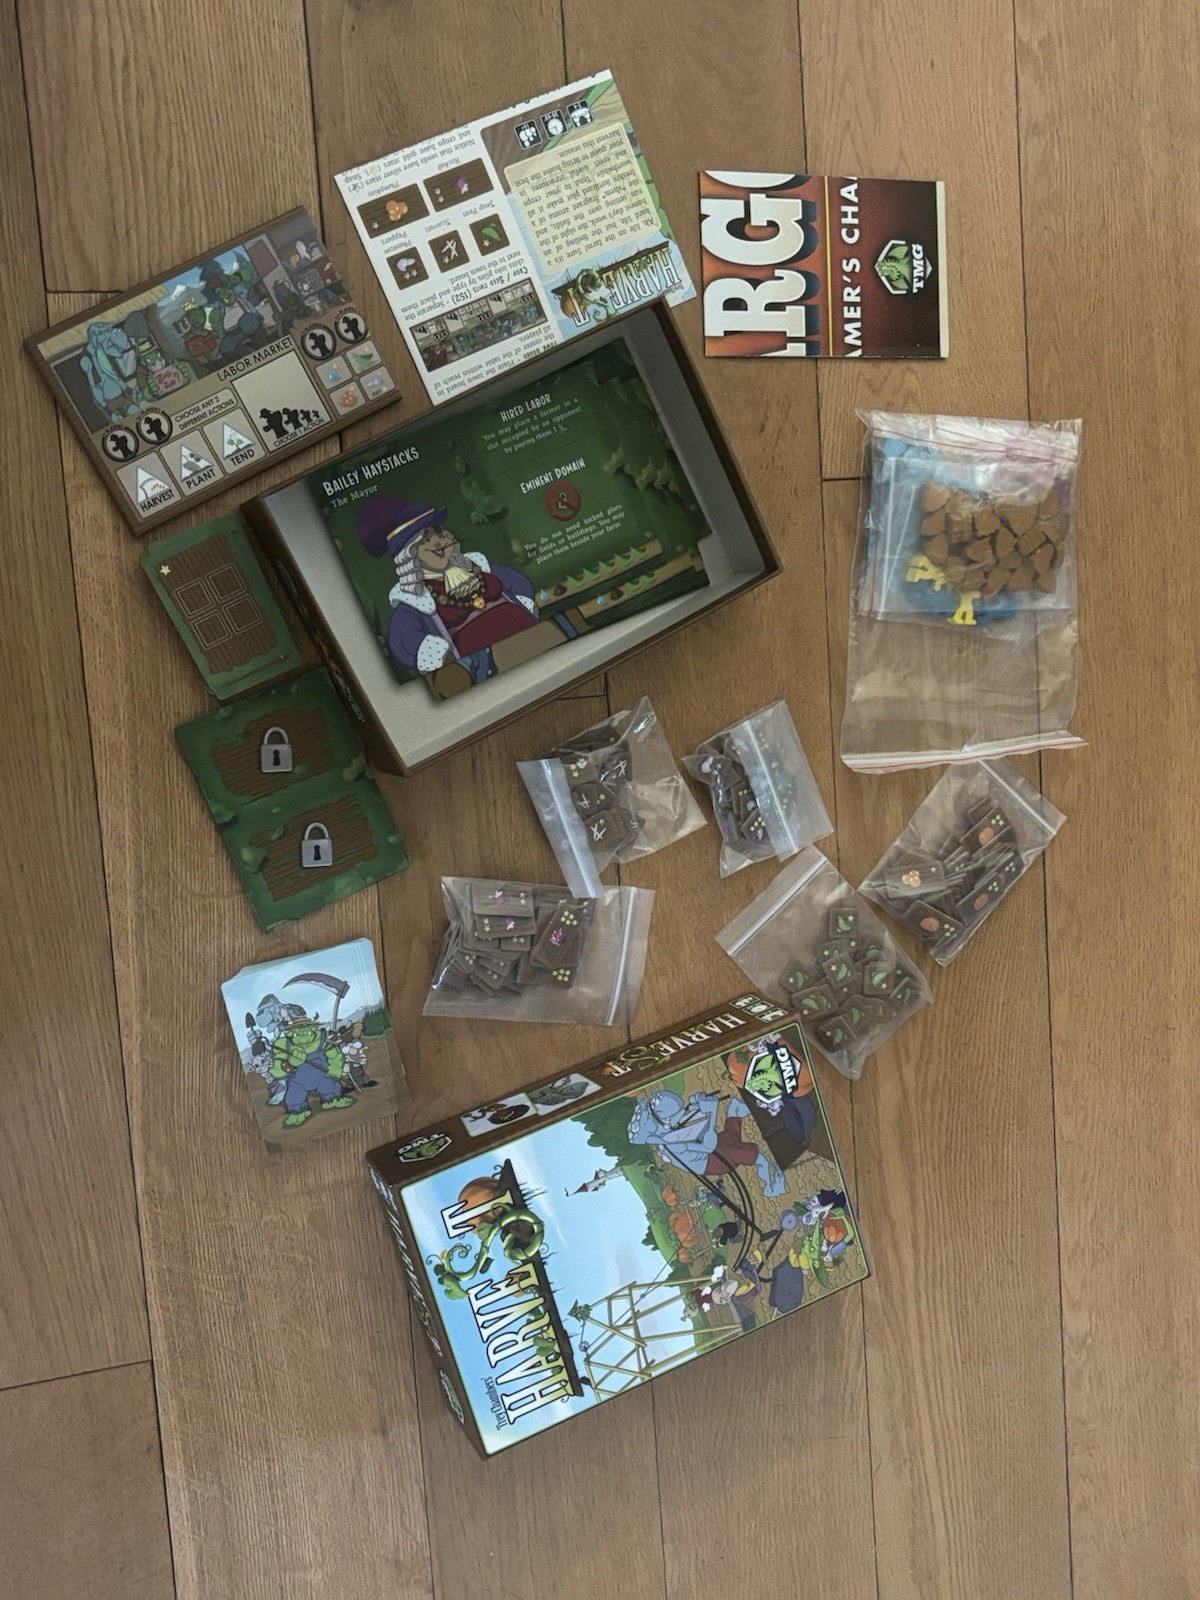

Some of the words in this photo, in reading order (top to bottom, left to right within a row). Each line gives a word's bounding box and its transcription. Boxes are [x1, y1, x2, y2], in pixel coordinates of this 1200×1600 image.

[437, 135, 456, 146] crops
[457, 129, 471, 140] and
[595, 129, 621, 144] harvest
[418, 143, 436, 154] have
[453, 138, 475, 150] Notice
[581, 139, 595, 148] this
[608, 137, 624, 150] your
[401, 149, 417, 162] gold
[438, 146, 453, 157] that
[558, 144, 581, 157] season.
[589, 144, 607, 158] quest
[614, 148, 627, 160] and
[382, 157, 400, 168] stars
[419, 152, 438, 164] seeds
[561, 156, 581, 168] bring
[580, 153, 589, 161] to
[593, 155, 611, 167] erect
[402, 159, 420, 170] have
[542, 163, 562, 176] home
[383, 166, 402, 179] silver
[529, 171, 542, 181] the
[568, 164, 589, 178] useful
[612, 168, 636, 182] freshly
[343, 172, 362, 184] Snap
[364, 174, 382, 185] stars
[513, 176, 530, 187] best
[530, 173, 565, 191] structures
[574, 175, 592, 188] Tend
[627, 178, 640, 187] the
[545, 185, 561, 198] your
[563, 182, 572, 190] to
[581, 178, 611, 196] fertilized
[518, 189, 527, 197] in
[566, 189, 580, 201] plot
[630, 188, 643, 197] sun
[522, 195, 541, 207] crops
[545, 197, 564, 209] make
[571, 194, 599, 210] fragrant
[604, 193, 627, 208] setting
[624, 197, 647, 211] honest
[526, 208, 535, 218] all
[537, 205, 544, 213] it
[548, 206, 569, 219] aroma
[587, 204, 602, 215] over
[607, 206, 624, 219] day's
[634, 207, 651, 220] hard
[840, 175, 859, 244] CHA
[537, 216, 546, 225] of
[573, 211, 585, 221] the
[587, 214, 607, 226] work,
[550, 217, 571, 230] fields,
[576, 221, 589, 231] the
[604, 221, 617, 231] but
[629, 222, 641, 232] life
[380, 230, 407, 245] Peppers
[534, 226, 548, 238] and
[558, 226, 576, 238] sight
[590, 227, 603, 236] the
[604, 233, 616, 242] the
[617, 228, 627, 236] on
[538, 237, 551, 246] the
[550, 233, 559, 243] of
[565, 233, 588, 247] feeling
[554, 243, 563, 253] of
[584, 238, 602, 252] farm!
[506, 250, 521, 261] next
[542, 248, 552, 256] an
[565, 247, 582, 258] Sure
[486, 259, 498, 268] the
[507, 257, 524, 268] chits
[553, 254, 564, 264] it's
[469, 264, 487, 275] town
[493, 264, 508, 274] into
[911, 243, 924, 292] TMG
[447, 271, 470, 285] board.
[476, 269, 493, 281] piles
[452, 281, 467, 292] type
[467, 277, 477, 286] by
[571, 244, 682, 327] HARVEST
[419, 292, 437, 305] place
[437, 288, 451, 299] and
[450, 288, 472, 305] (152)
[400, 301, 418, 313] them
[416, 300, 445, 316] Separate
[403, 312, 416, 321] the
[517, 327, 542, 342] players.
[542, 324, 551, 334] all
[543, 332, 555, 341] the
[522, 337, 542, 350] center
[501, 350, 513, 359] the
[513, 346, 521, 355] of
[216, 357, 252, 381] LABOR
[252, 336, 292, 363] MARKET
[484, 355, 501, 366] table
[461, 363, 483, 376] within
[485, 366, 496, 375] the
[441, 372, 461, 385] reach
[466, 372, 484, 383] town
[432, 381, 441, 390] of
[445, 379, 466, 394] board
[436, 388, 445, 396] in
[174, 405, 201, 422] CHOOSE
[200, 397, 214, 409] ANY
[213, 395, 220, 403] 2
[499, 404, 524, 422] HIRED
[524, 393, 551, 411] LABOR
[551, 405, 581, 422] opponent
[178, 411, 207, 430] DIFFERENT
[207, 398, 234, 416] ACTIONS
[513, 417, 530, 430] place
[273, 429, 299, 447] CHOOSE
[302, 417, 324, 432] ACTION
[513, 436, 535, 451] paying
[534, 429, 552, 440] them
[229, 448, 255, 465] TEND
[322, 470, 359, 496] BAILEY
[361, 446, 419, 479] HAYSTACKS
[519, 471, 553, 493] EMINENT
[554, 457, 585, 478] DOMAIN
[185, 468, 215, 489] PLANT
[139, 488, 174, 512] HARVEST
[330, 496, 348, 508] The
[349, 484, 377, 500] Mayor
[523, 541, 537, 550] You
[539, 536, 549, 544] do
[551, 529, 562, 539] not
[565, 520, 581, 533] need
[606, 503, 622, 516] plots
[597, 517, 610, 526] You
[535, 552, 552, 564] place
[552, 544, 569, 555] them
[590, 528, 604, 540] your
[602, 1012, 748, 1077] HARVEST
[774, 1045, 798, 1096] TMG
[427, 1189, 574, 1425] HARVEST
[479, 1373, 502, 1414] Chambers'
[491, 1410, 508, 1431] Trey
